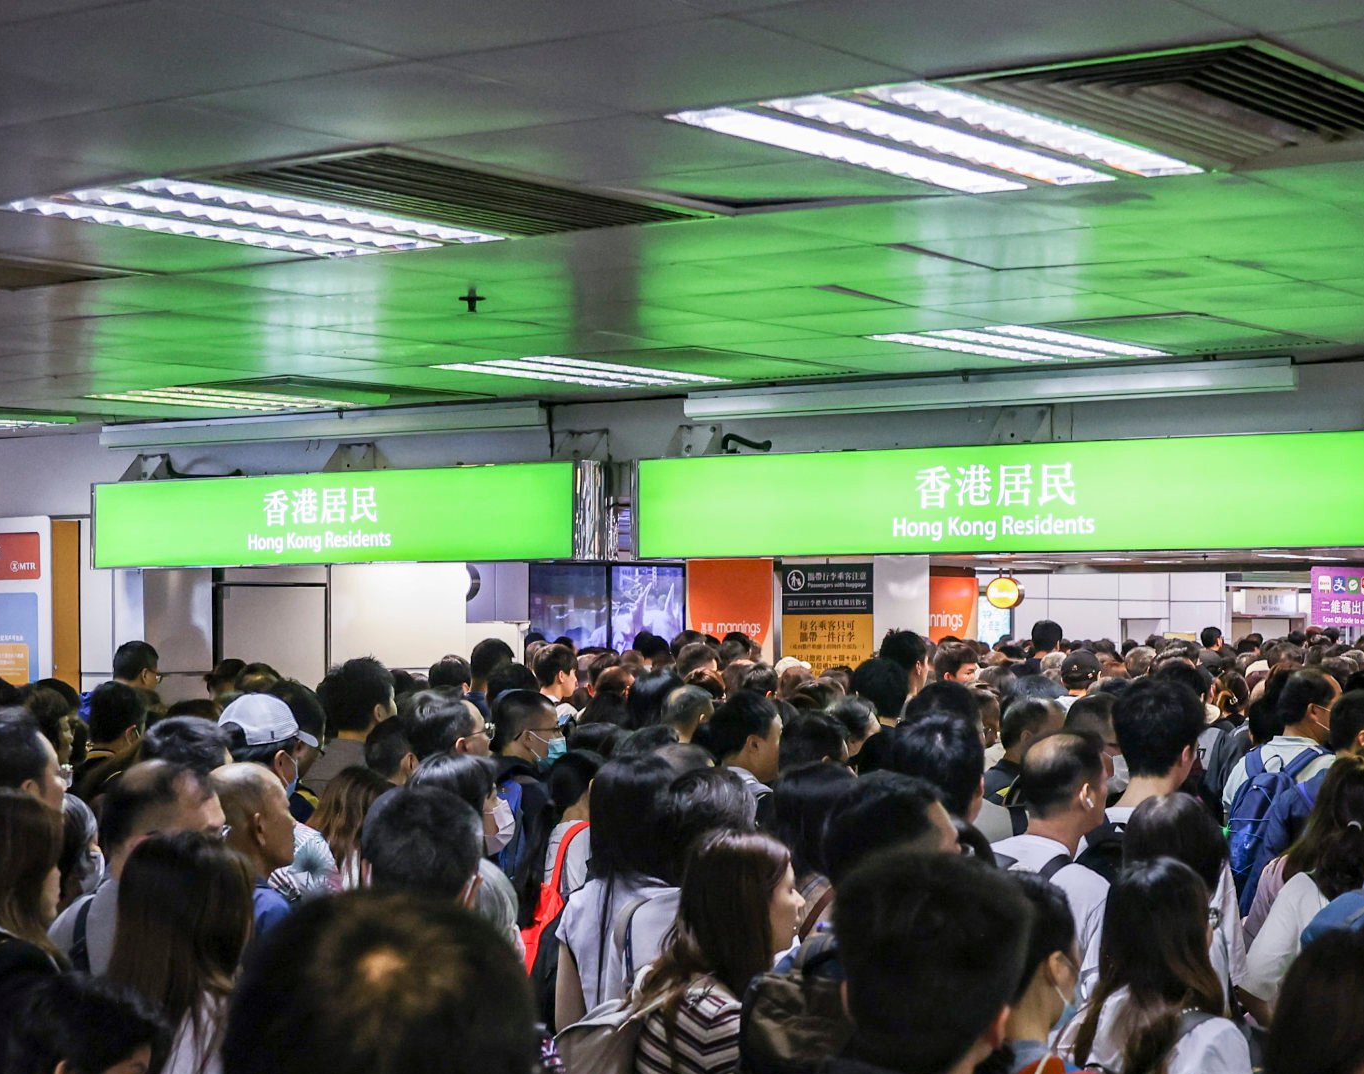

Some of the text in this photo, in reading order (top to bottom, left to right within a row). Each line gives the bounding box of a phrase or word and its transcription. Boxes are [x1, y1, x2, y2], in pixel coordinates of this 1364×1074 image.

[915, 462, 1076, 510] 香港居民
[263, 486, 378, 527] 香港居民
[893, 513, 1095, 541] Hong Kong Residents
[248, 529, 391, 554] Hong Kong Residents
[19, 562, 36, 570] MTR
[717, 620, 761, 637] mannings
